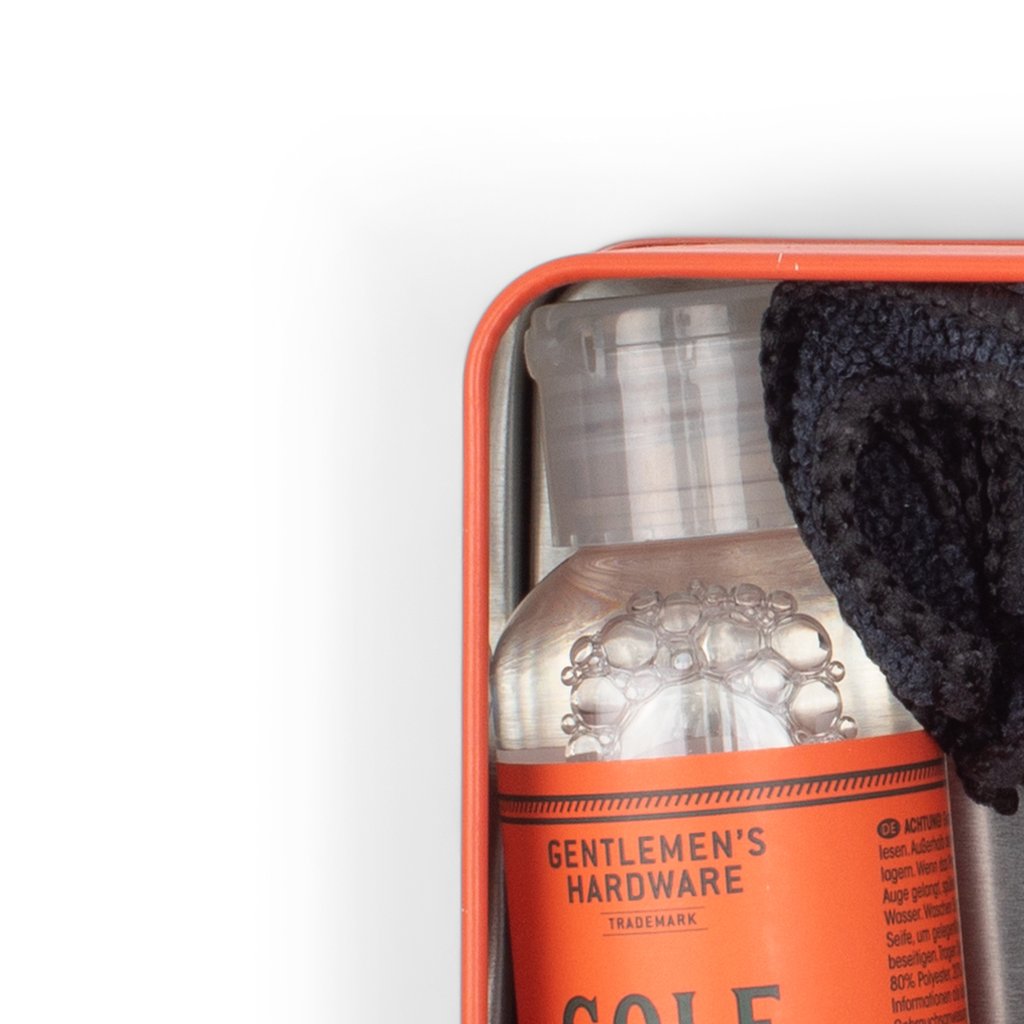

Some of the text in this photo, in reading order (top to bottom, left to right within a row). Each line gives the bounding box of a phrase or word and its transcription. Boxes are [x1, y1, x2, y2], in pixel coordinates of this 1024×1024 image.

[879, 819, 899, 837] DE
[548, 827, 767, 869] GENTLEMEN'S
[879, 845, 911, 861] lesen.
[567, 865, 744, 904] HARDWARE
[884, 888, 909, 905] Auge
[609, 912, 697, 930] TRADEMARK
[917, 929, 930, 943] um
[890, 972, 916, 991] 80%
